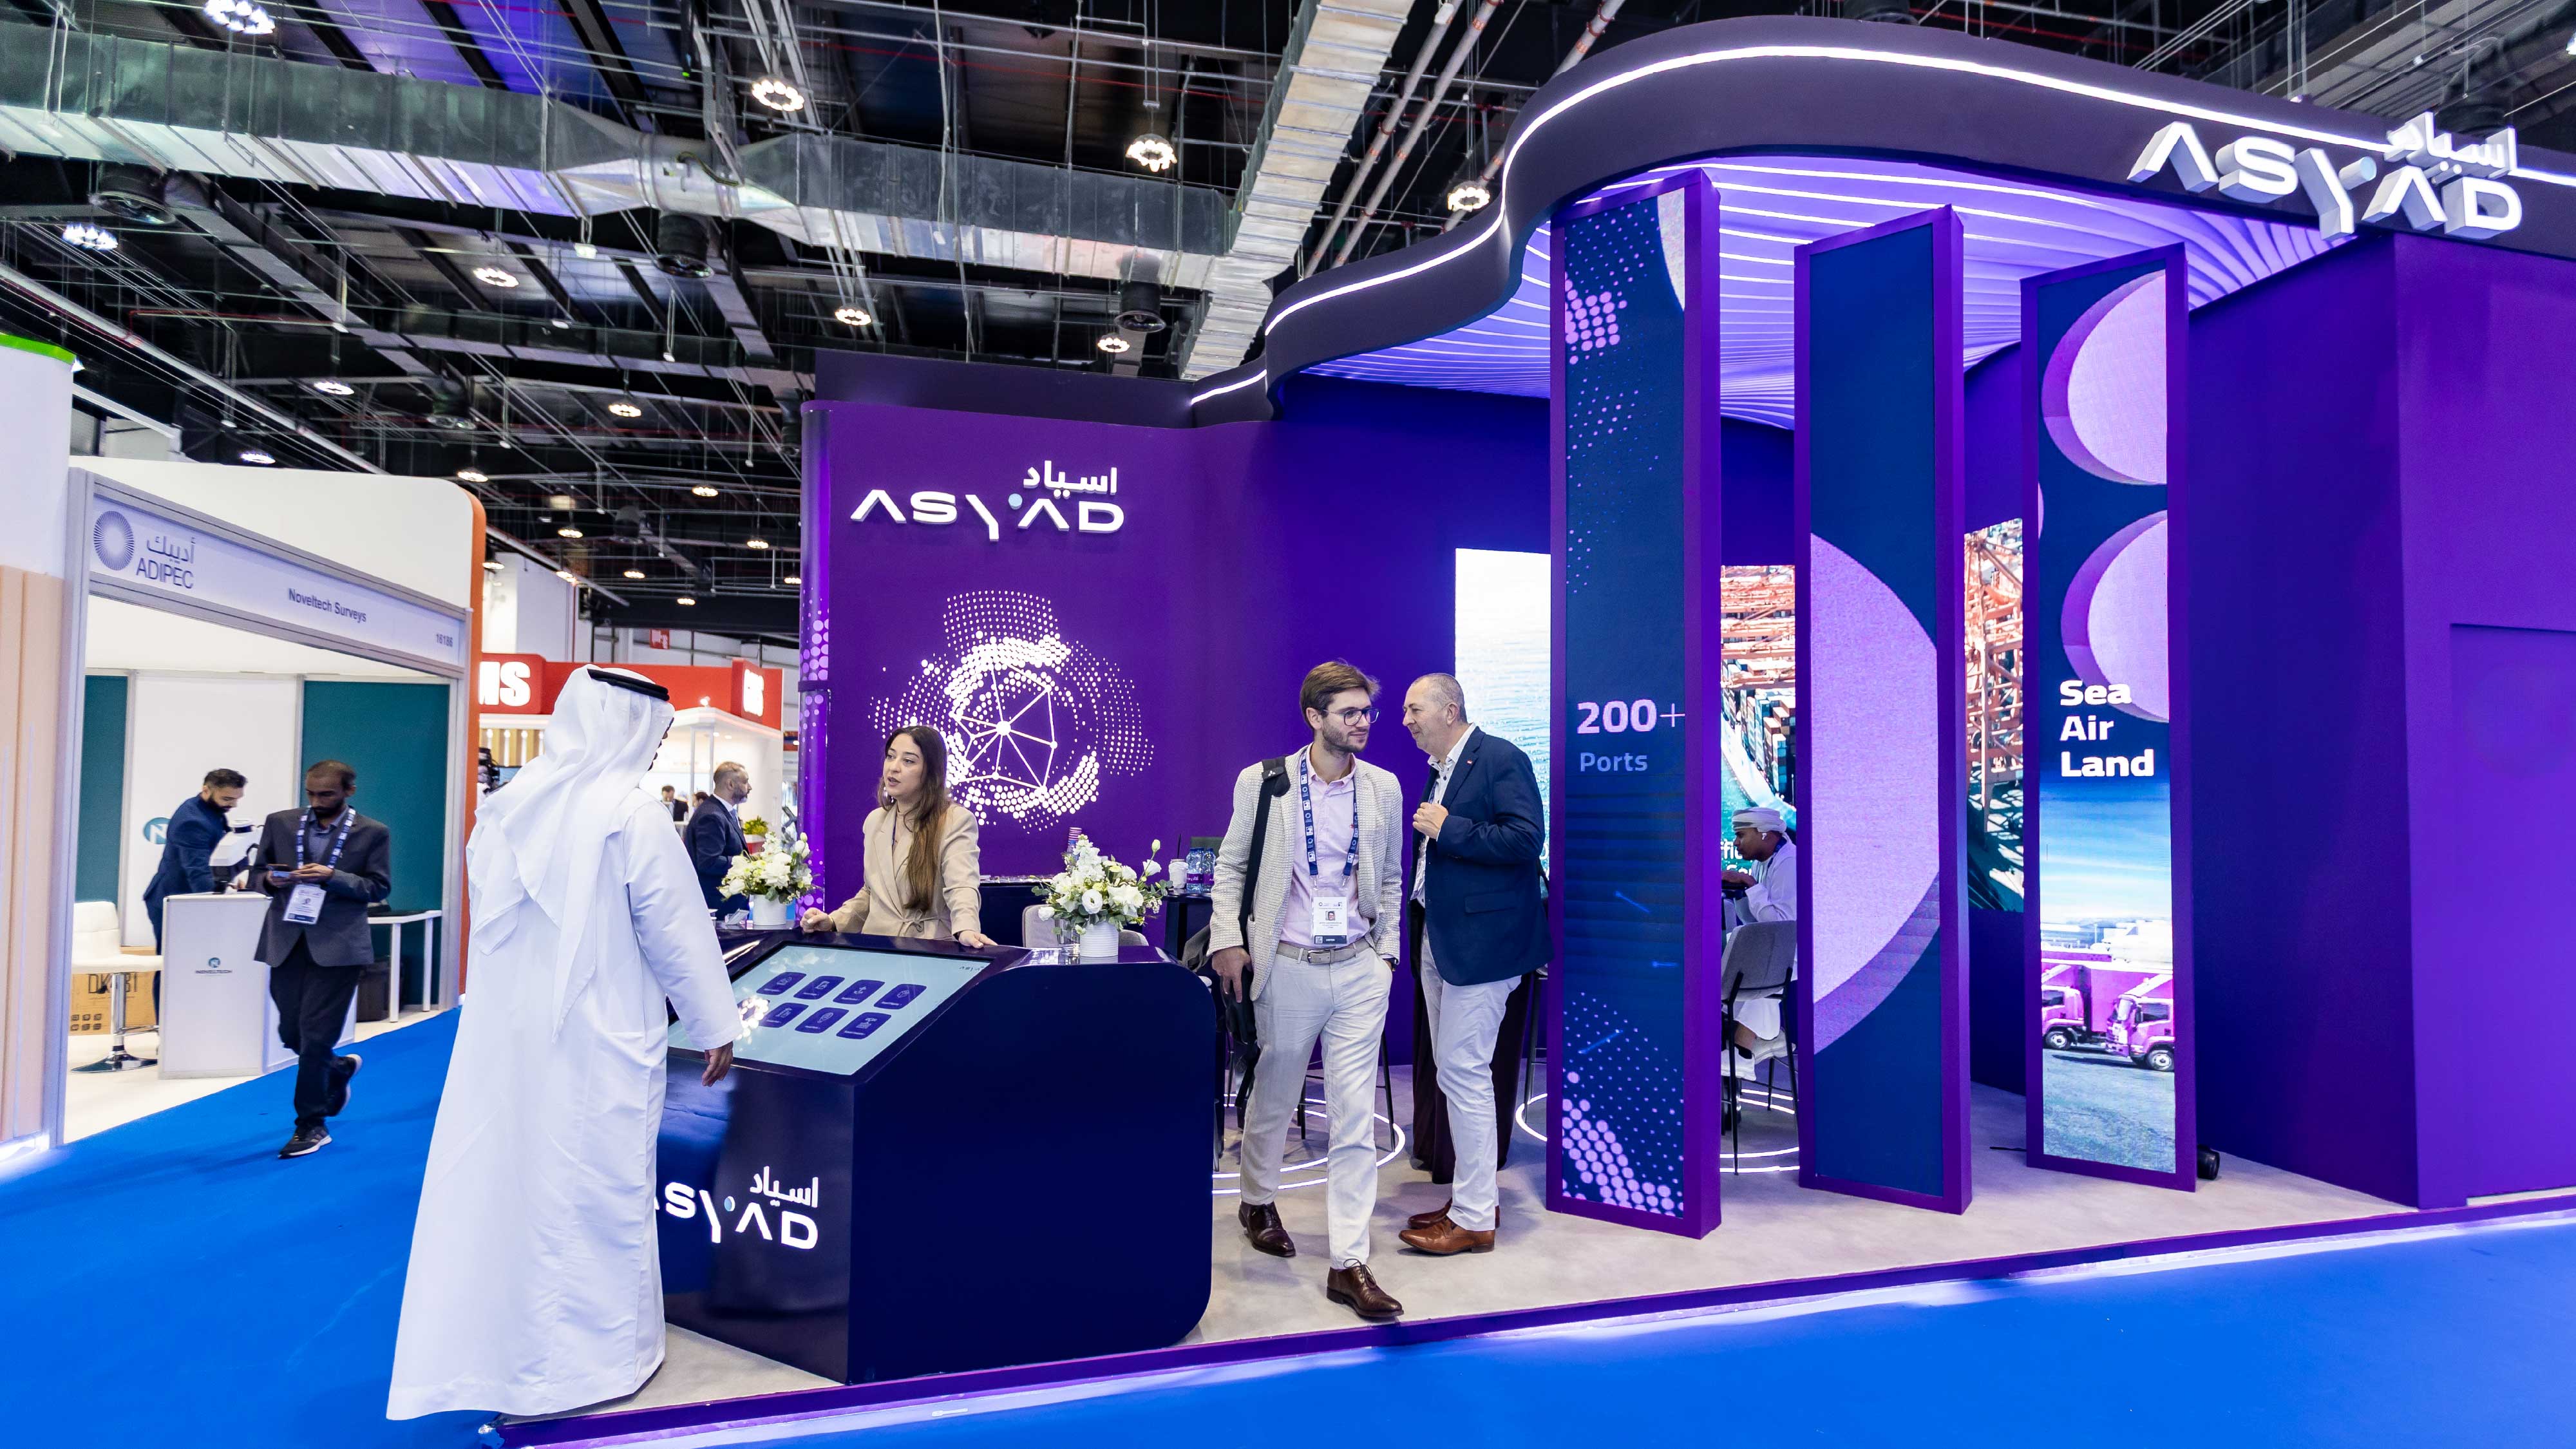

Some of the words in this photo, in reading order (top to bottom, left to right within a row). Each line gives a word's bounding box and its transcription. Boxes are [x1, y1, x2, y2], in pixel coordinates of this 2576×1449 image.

[2384, 111, 2517, 180] اسياد
[2126, 120, 2523, 241] ASYAD
[1023, 460, 1118, 499] اسياد
[850, 489, 1124, 542] ASYAD
[146, 535, 196, 564] أديبك
[136, 557, 194, 589] ADIPEC
[289, 587, 332, 612] Noveltech
[334, 602, 367, 623] Surveys
[2060, 679, 2133, 706] Sea
[1577, 698, 1686, 735] 200+
[2059, 715, 2115, 741] Air
[1580, 752, 1649, 772] Ports
[2061, 748, 2155, 778] Land
[749, 1166, 819, 1208] اسياد
[653, 1181, 819, 1250] SYAD
